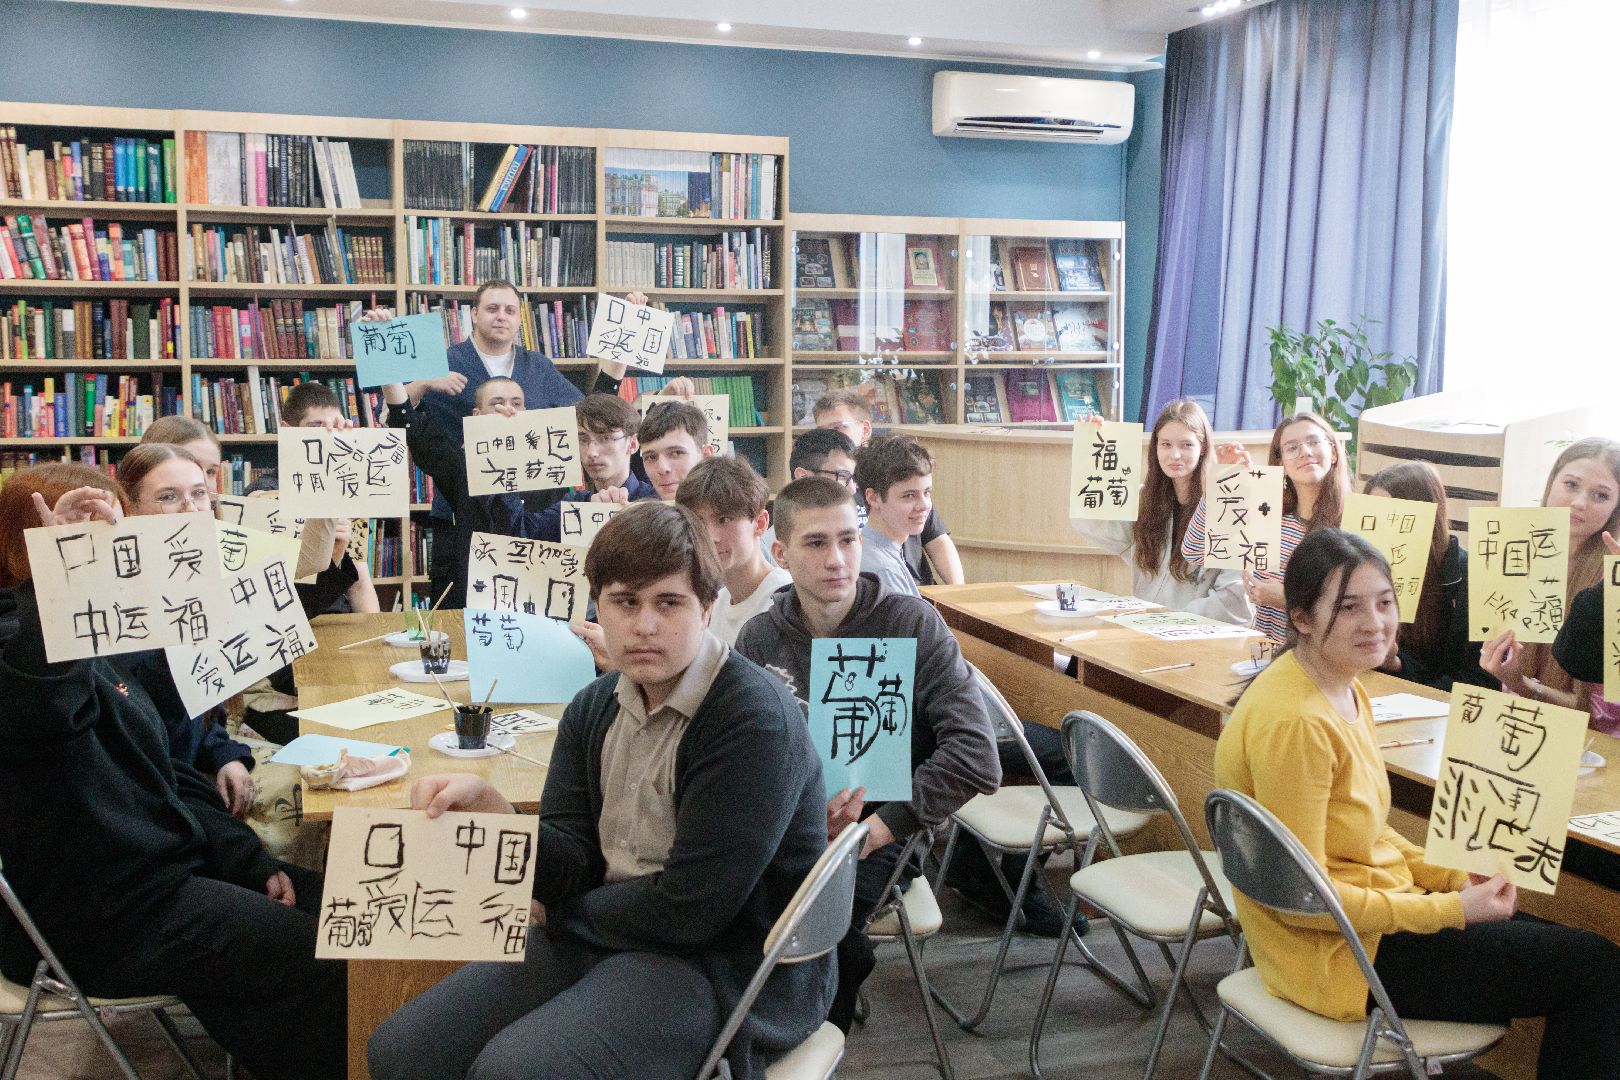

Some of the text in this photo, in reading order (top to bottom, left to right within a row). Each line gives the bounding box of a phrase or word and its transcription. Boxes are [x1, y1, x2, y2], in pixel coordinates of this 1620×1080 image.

[1091, 431, 1119, 471] 福
[1077, 475, 1129, 509] 葡萄
[1216, 472, 1249, 526] 爱
